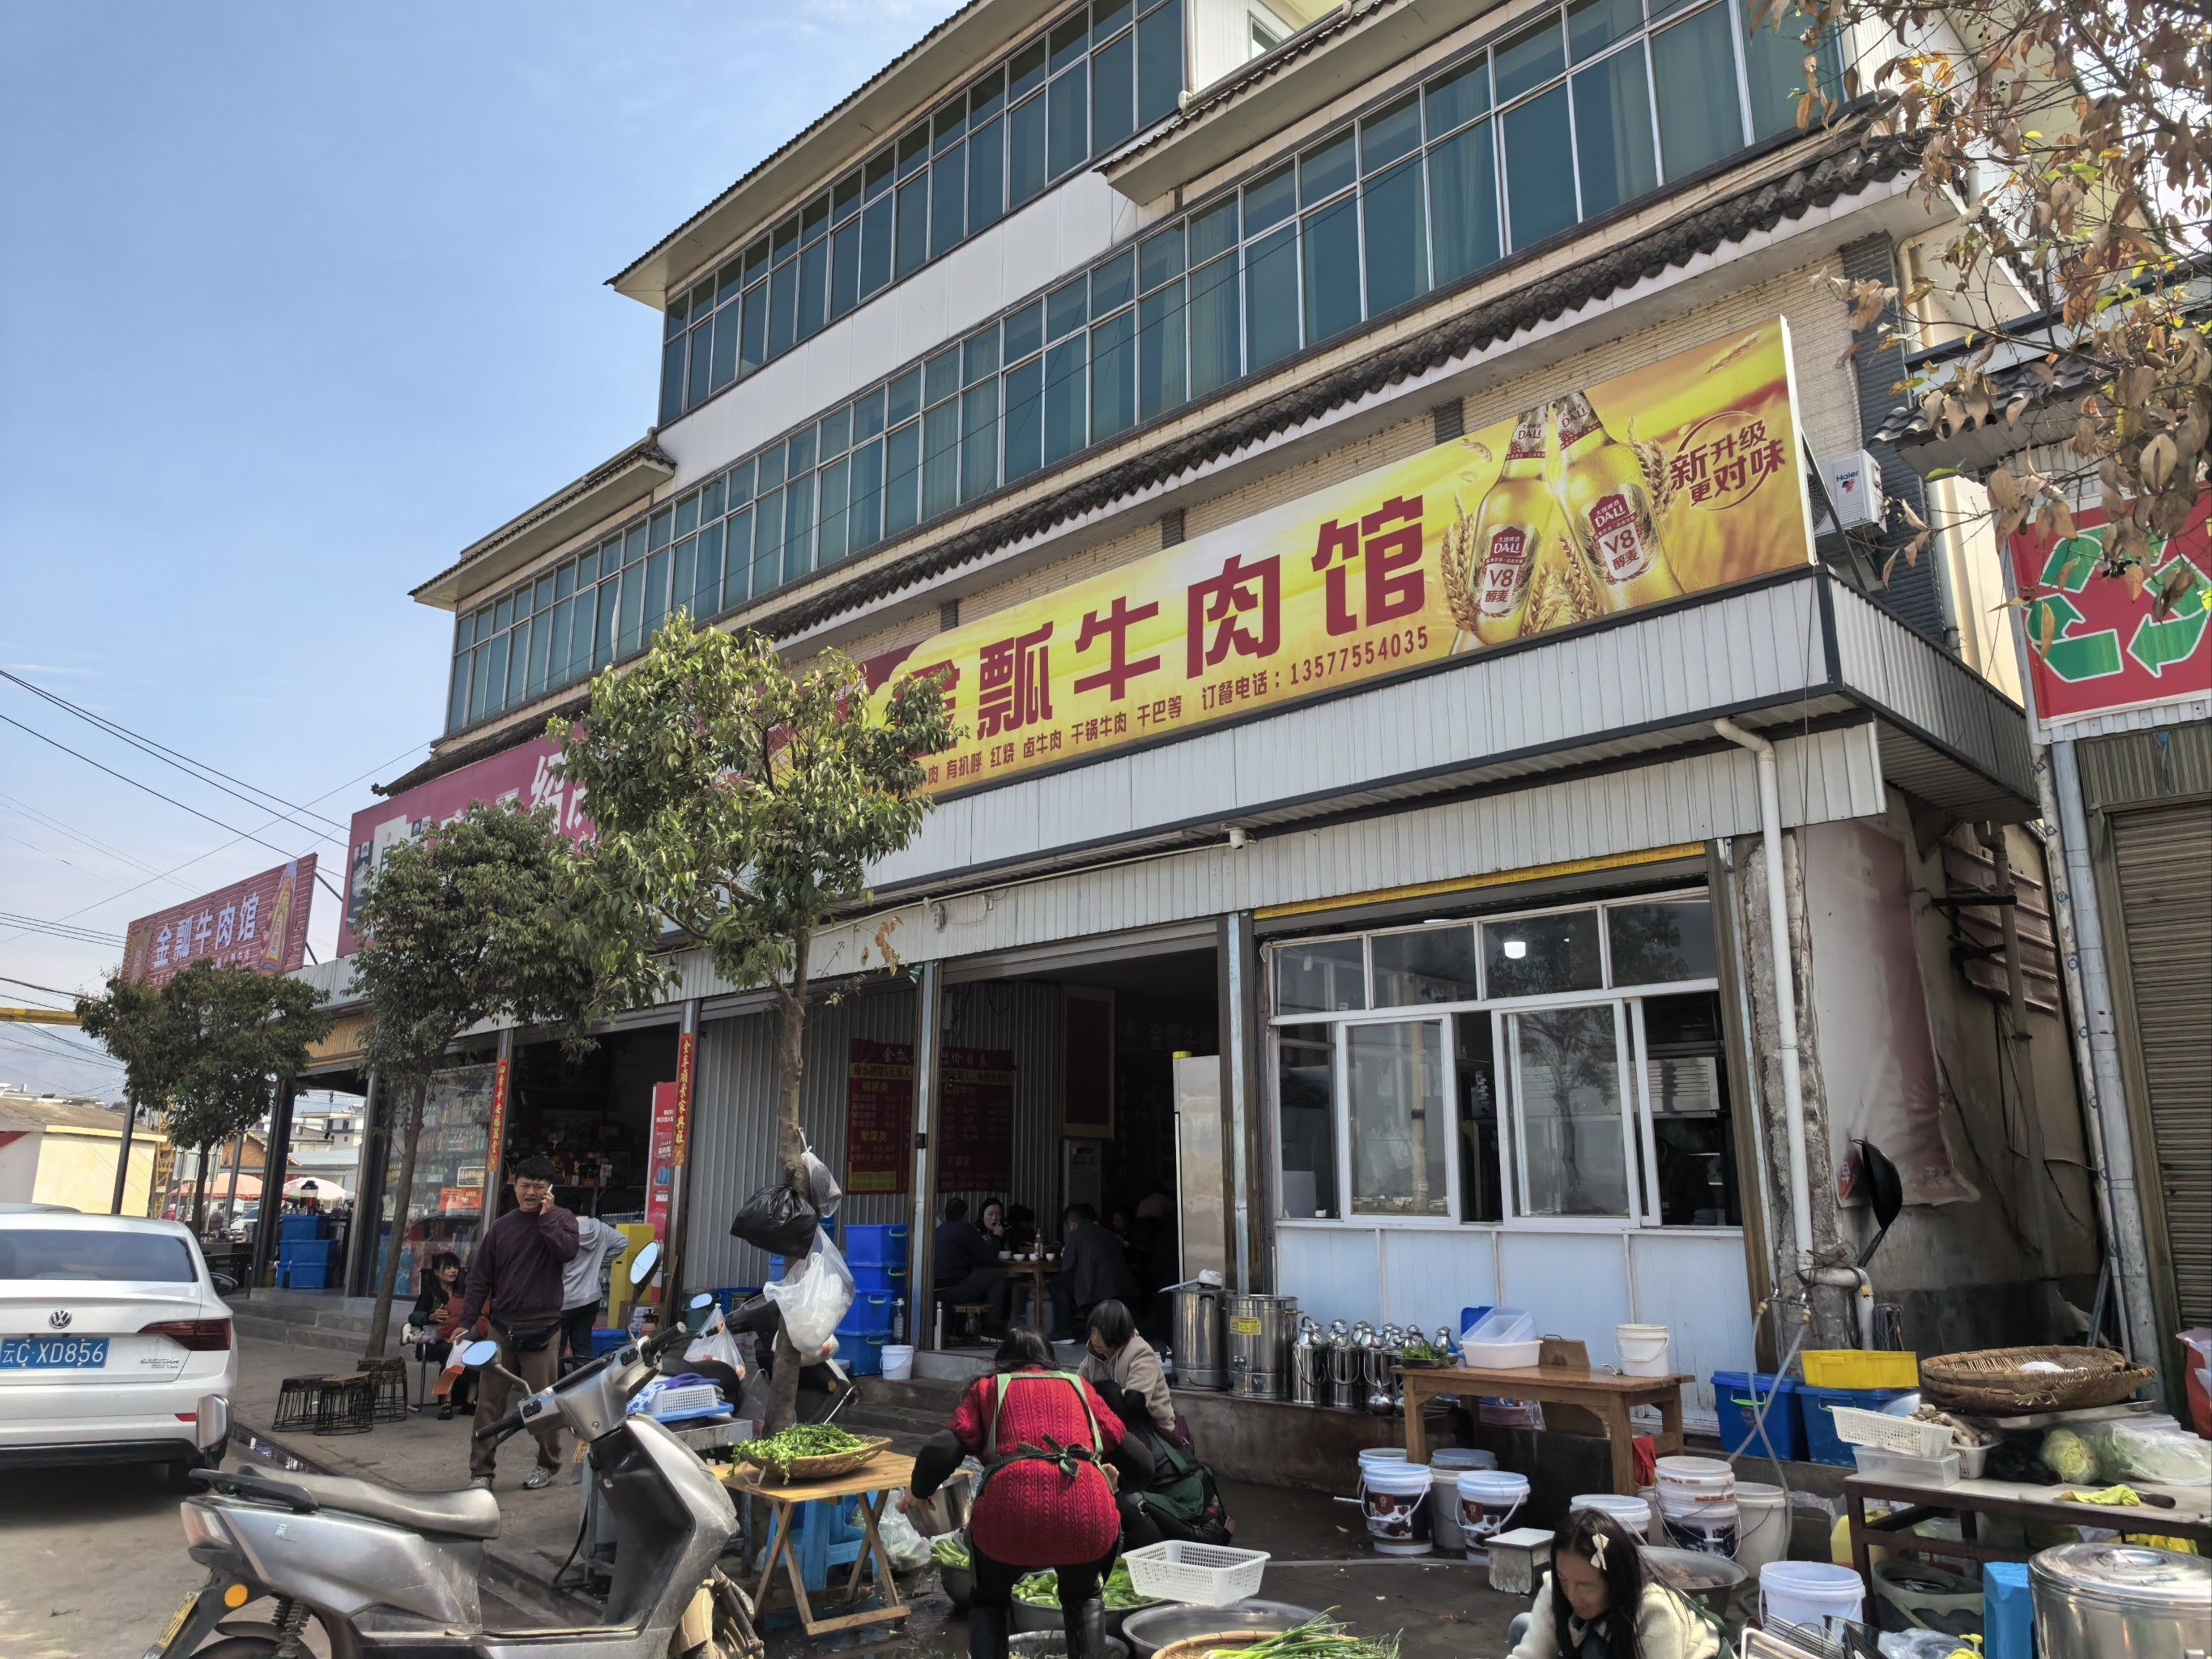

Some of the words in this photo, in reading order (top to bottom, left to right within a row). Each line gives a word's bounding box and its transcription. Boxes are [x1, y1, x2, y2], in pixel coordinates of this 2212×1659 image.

[1669, 419, 1767, 492] 新升级
[1690, 437, 1786, 507] 更对味
[1836, 470, 1860, 482] Haier
[1603, 529, 1635, 555] V8
[1490, 569, 1515, 587] V8
[990, 742, 1015, 768] 红烧
[1023, 729, 1062, 759] 卤牛肉
[1071, 711, 1127, 745] 干锅牛肉
[1136, 695, 1183, 727] 干巴等
[153, 890, 260, 970] 金瓢牛肉馆
